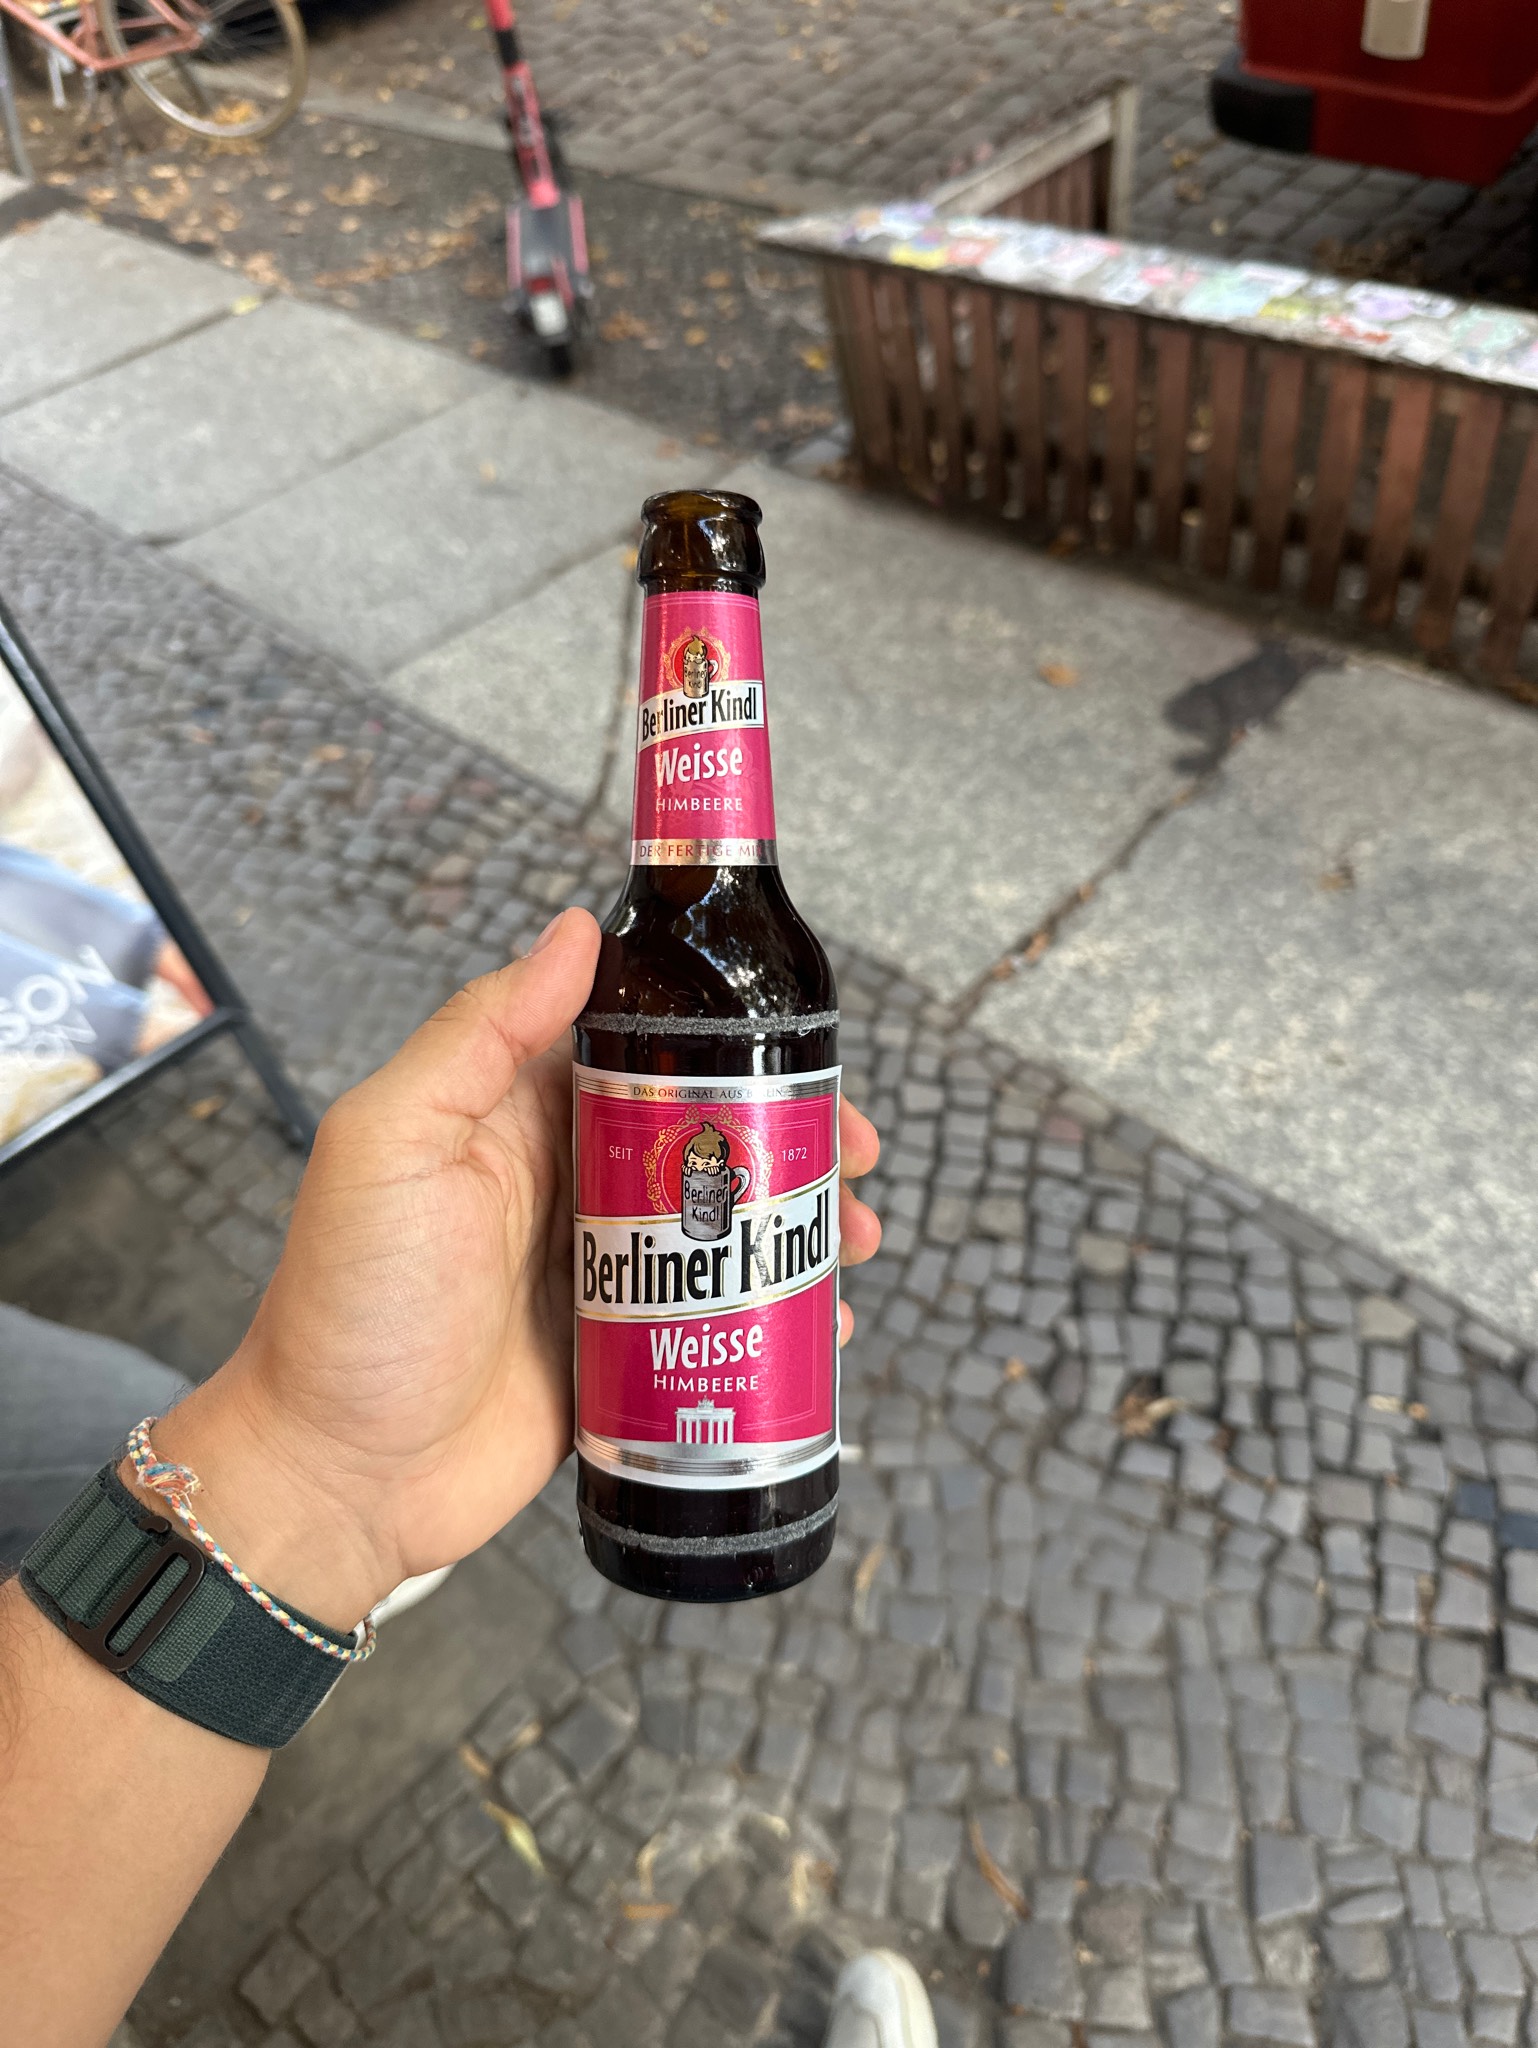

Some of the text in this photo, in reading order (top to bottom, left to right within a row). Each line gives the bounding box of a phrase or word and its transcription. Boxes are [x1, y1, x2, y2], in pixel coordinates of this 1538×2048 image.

[642, 688, 757, 742] Berliner Kindl
[655, 743, 743, 787] Weisse
[655, 798, 743, 812] HIMBEERE
[639, 844, 661, 858] DER
[667, 844, 732, 857] FERTIGE
[633, 1086, 783, 1099] DAS ORIGINAL AUS BLIN
[608, 1146, 808, 1162] SEIT 1872
[684, 1180, 728, 1204] Berliner
[692, 1205, 719, 1222] Kindl
[583, 1188, 830, 1304] Berliner Kindl
[649, 1323, 763, 1371] Weisse
[653, 1374, 759, 1393] HIMBEERE
